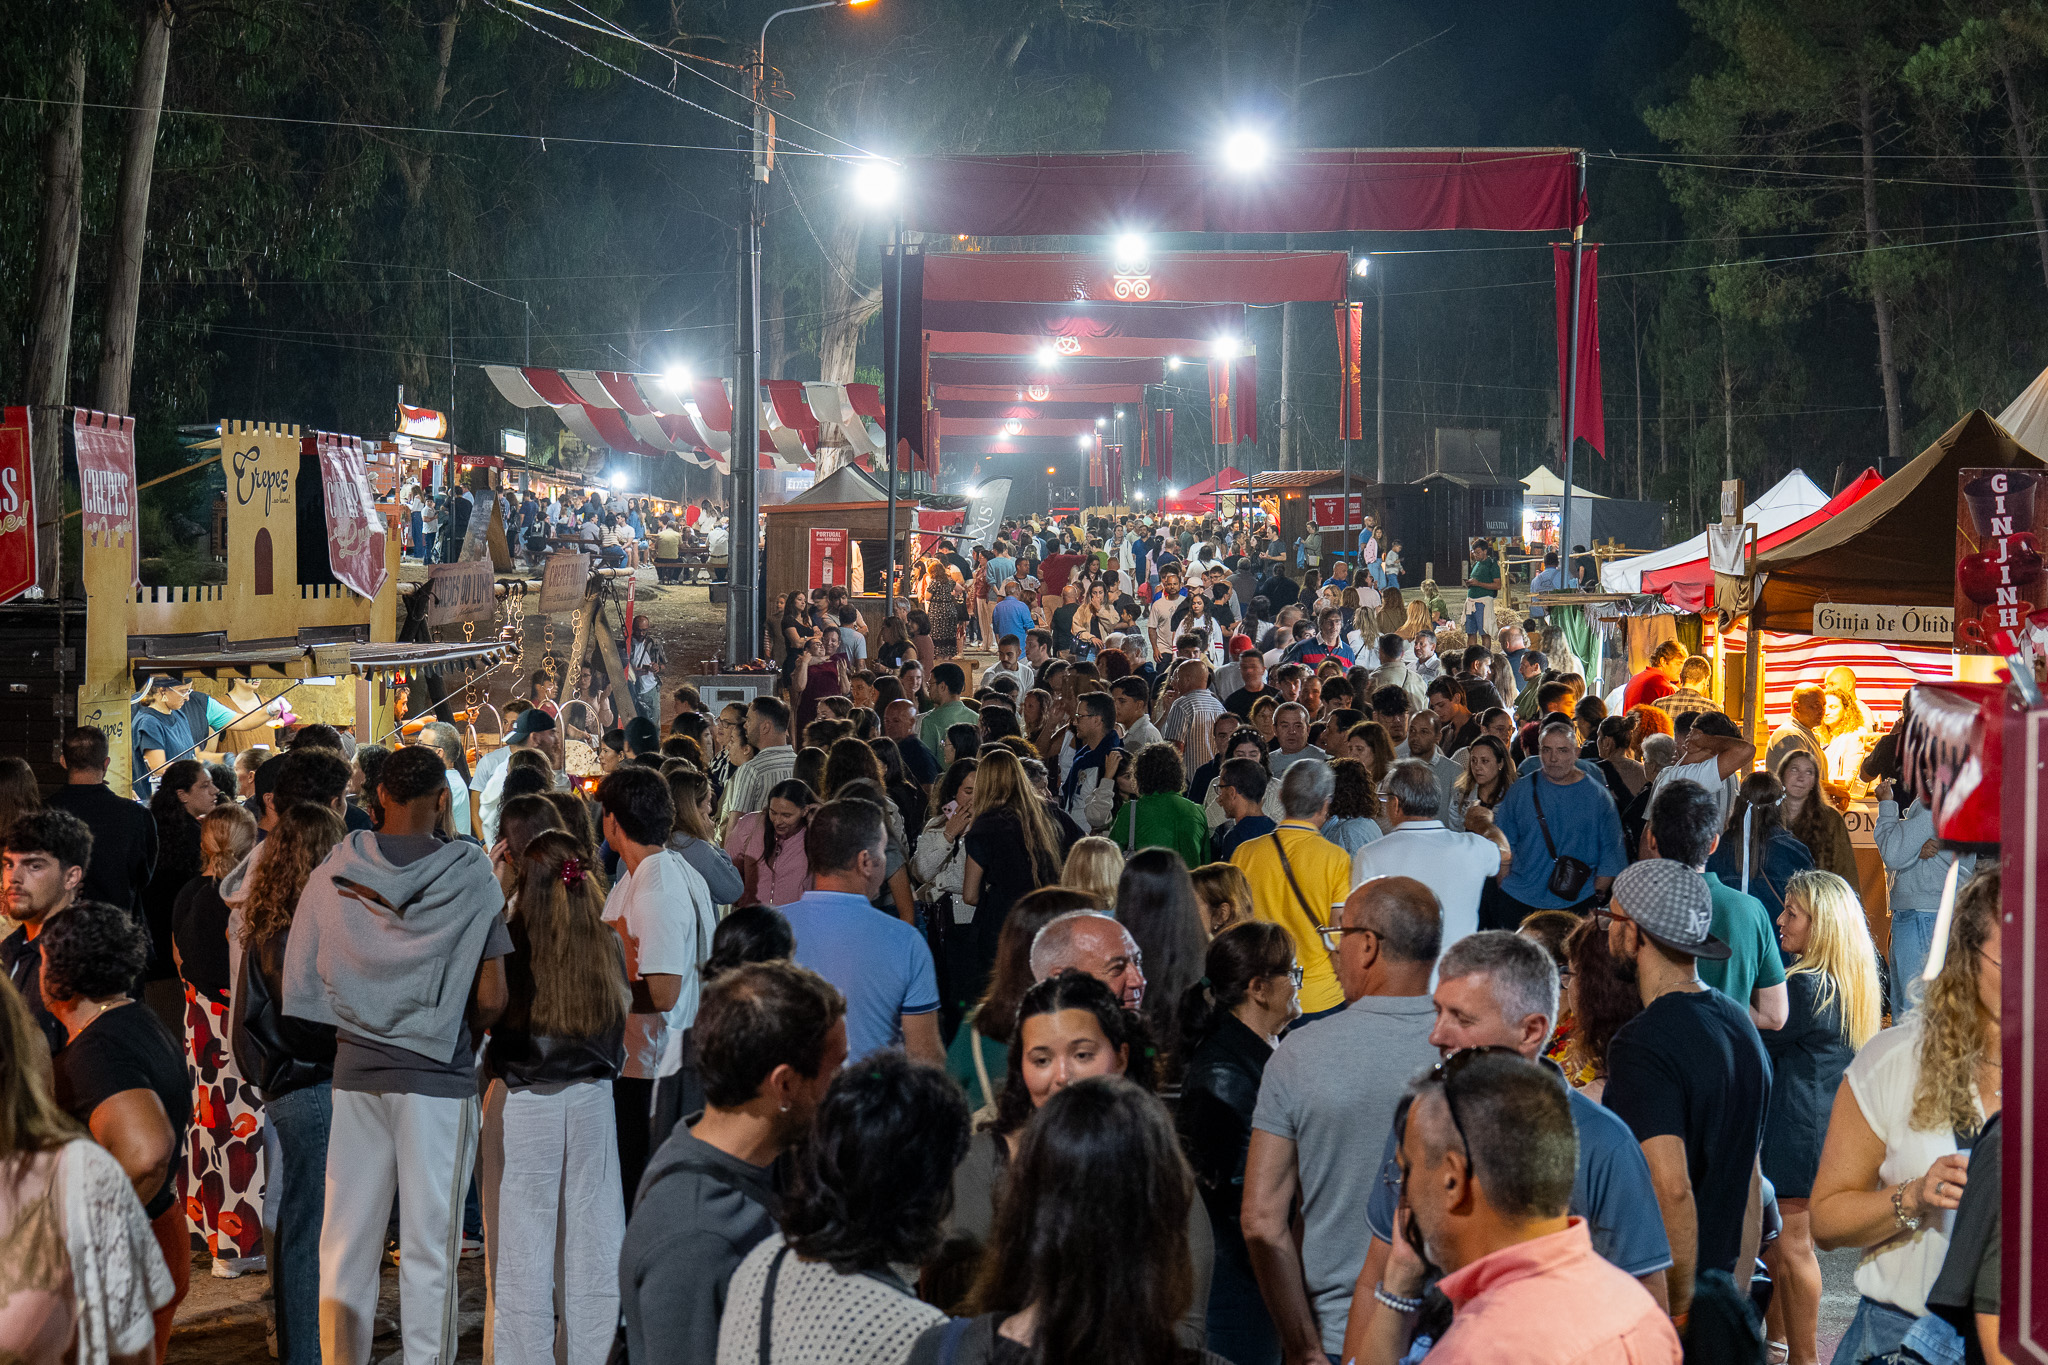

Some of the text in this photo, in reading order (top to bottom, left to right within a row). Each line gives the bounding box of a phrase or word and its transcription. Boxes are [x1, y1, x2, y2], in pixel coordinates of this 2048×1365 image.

[462, 455, 485, 465] CREPES
[84, 468, 129, 517] CREPES
[233, 445, 289, 518] Crepes
[1818, 607, 1954, 637] Ginja de Óbid
